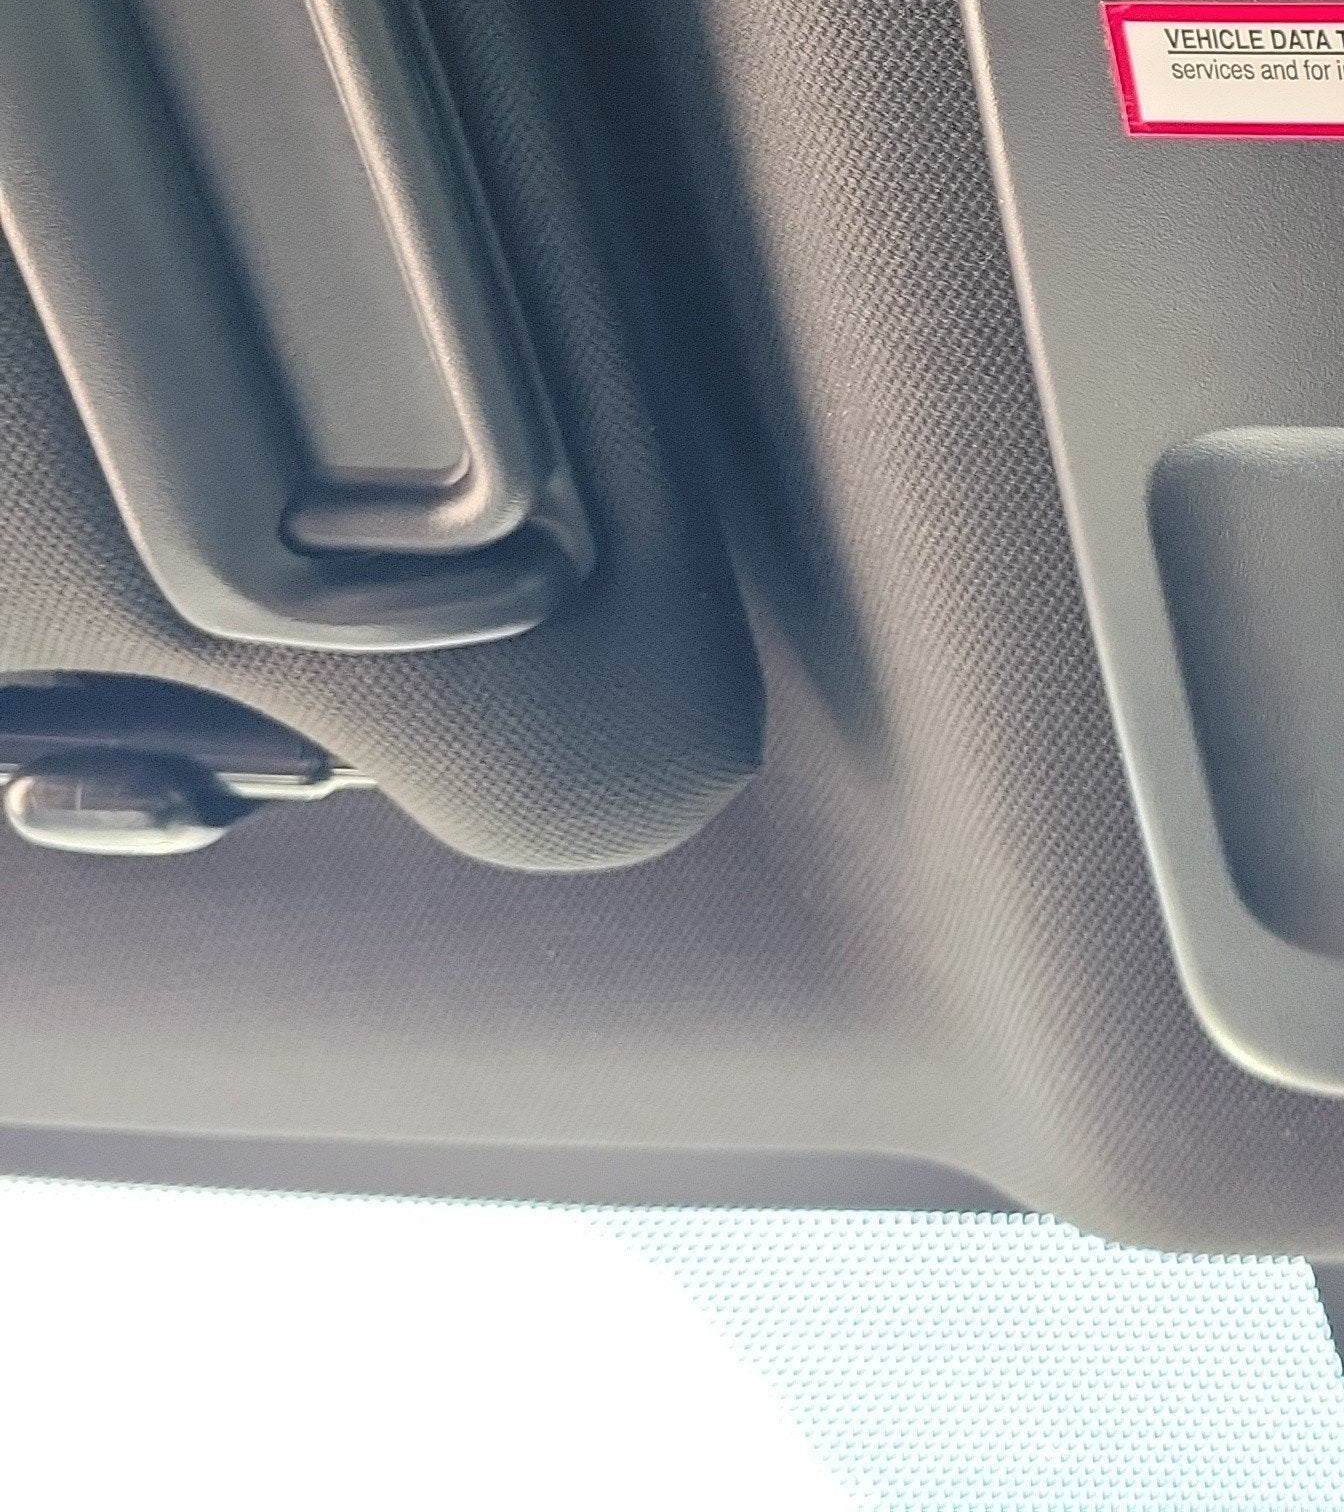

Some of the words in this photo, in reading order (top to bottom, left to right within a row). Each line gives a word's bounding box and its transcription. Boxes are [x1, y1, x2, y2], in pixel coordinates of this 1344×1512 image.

[1165, 28, 1264, 49] VEHICLE
[1271, 29, 1332, 50] DATA
[1172, 61, 1254, 81] services
[1261, 61, 1298, 81] and
[1304, 61, 1331, 81] for
